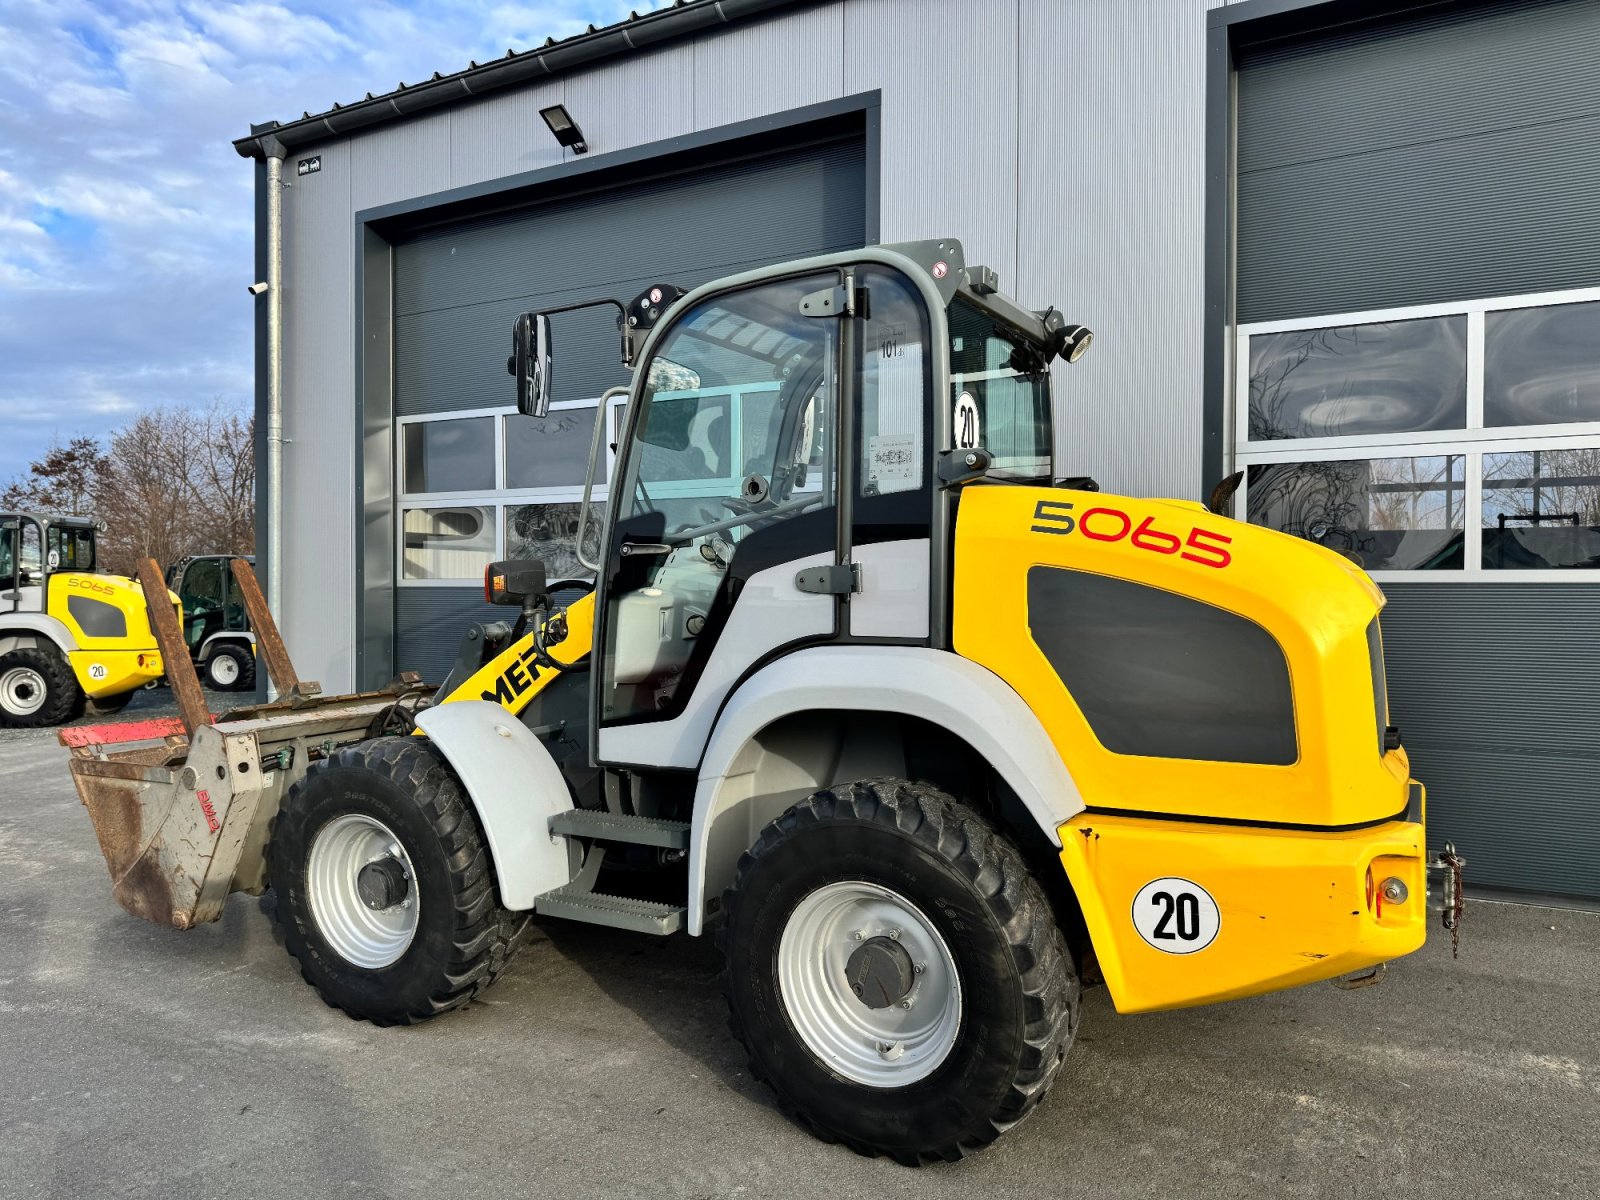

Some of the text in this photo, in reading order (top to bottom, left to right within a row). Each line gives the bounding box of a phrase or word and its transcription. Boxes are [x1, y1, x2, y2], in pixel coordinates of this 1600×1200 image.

[880, 339, 897, 359] 101
[960, 404, 975, 449] 20
[1030, 500, 1233, 569] 5065
[67, 578, 116, 596] 5065
[92, 665, 104, 678] 20
[1151, 891, 1200, 941] 20
